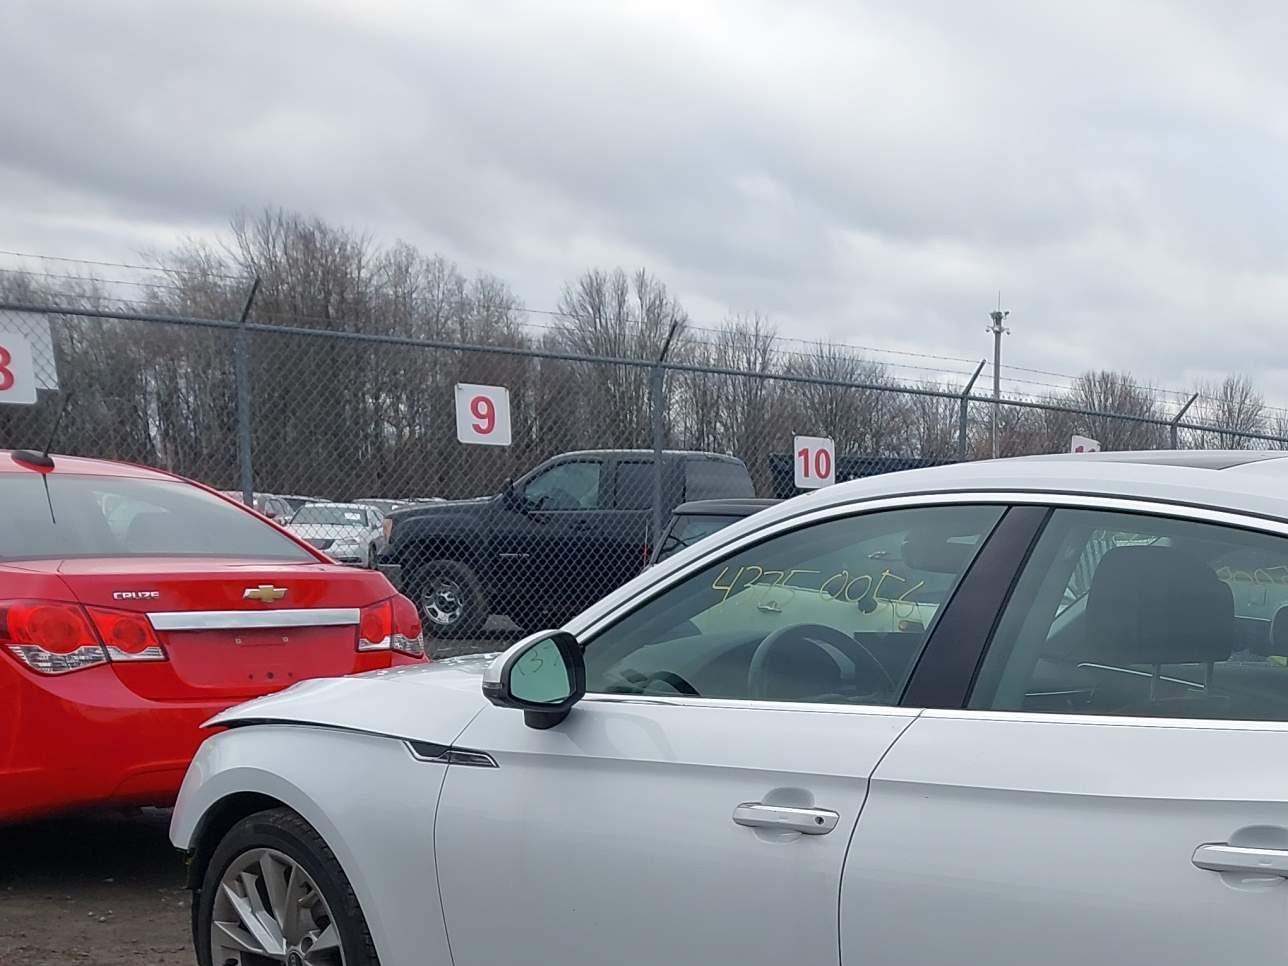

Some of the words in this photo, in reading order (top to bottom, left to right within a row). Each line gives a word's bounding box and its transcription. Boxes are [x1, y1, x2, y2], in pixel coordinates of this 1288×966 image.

[470, 395, 496, 435] 9
[798, 447, 831, 480] 10
[112, 591, 160, 600] CRUZE
